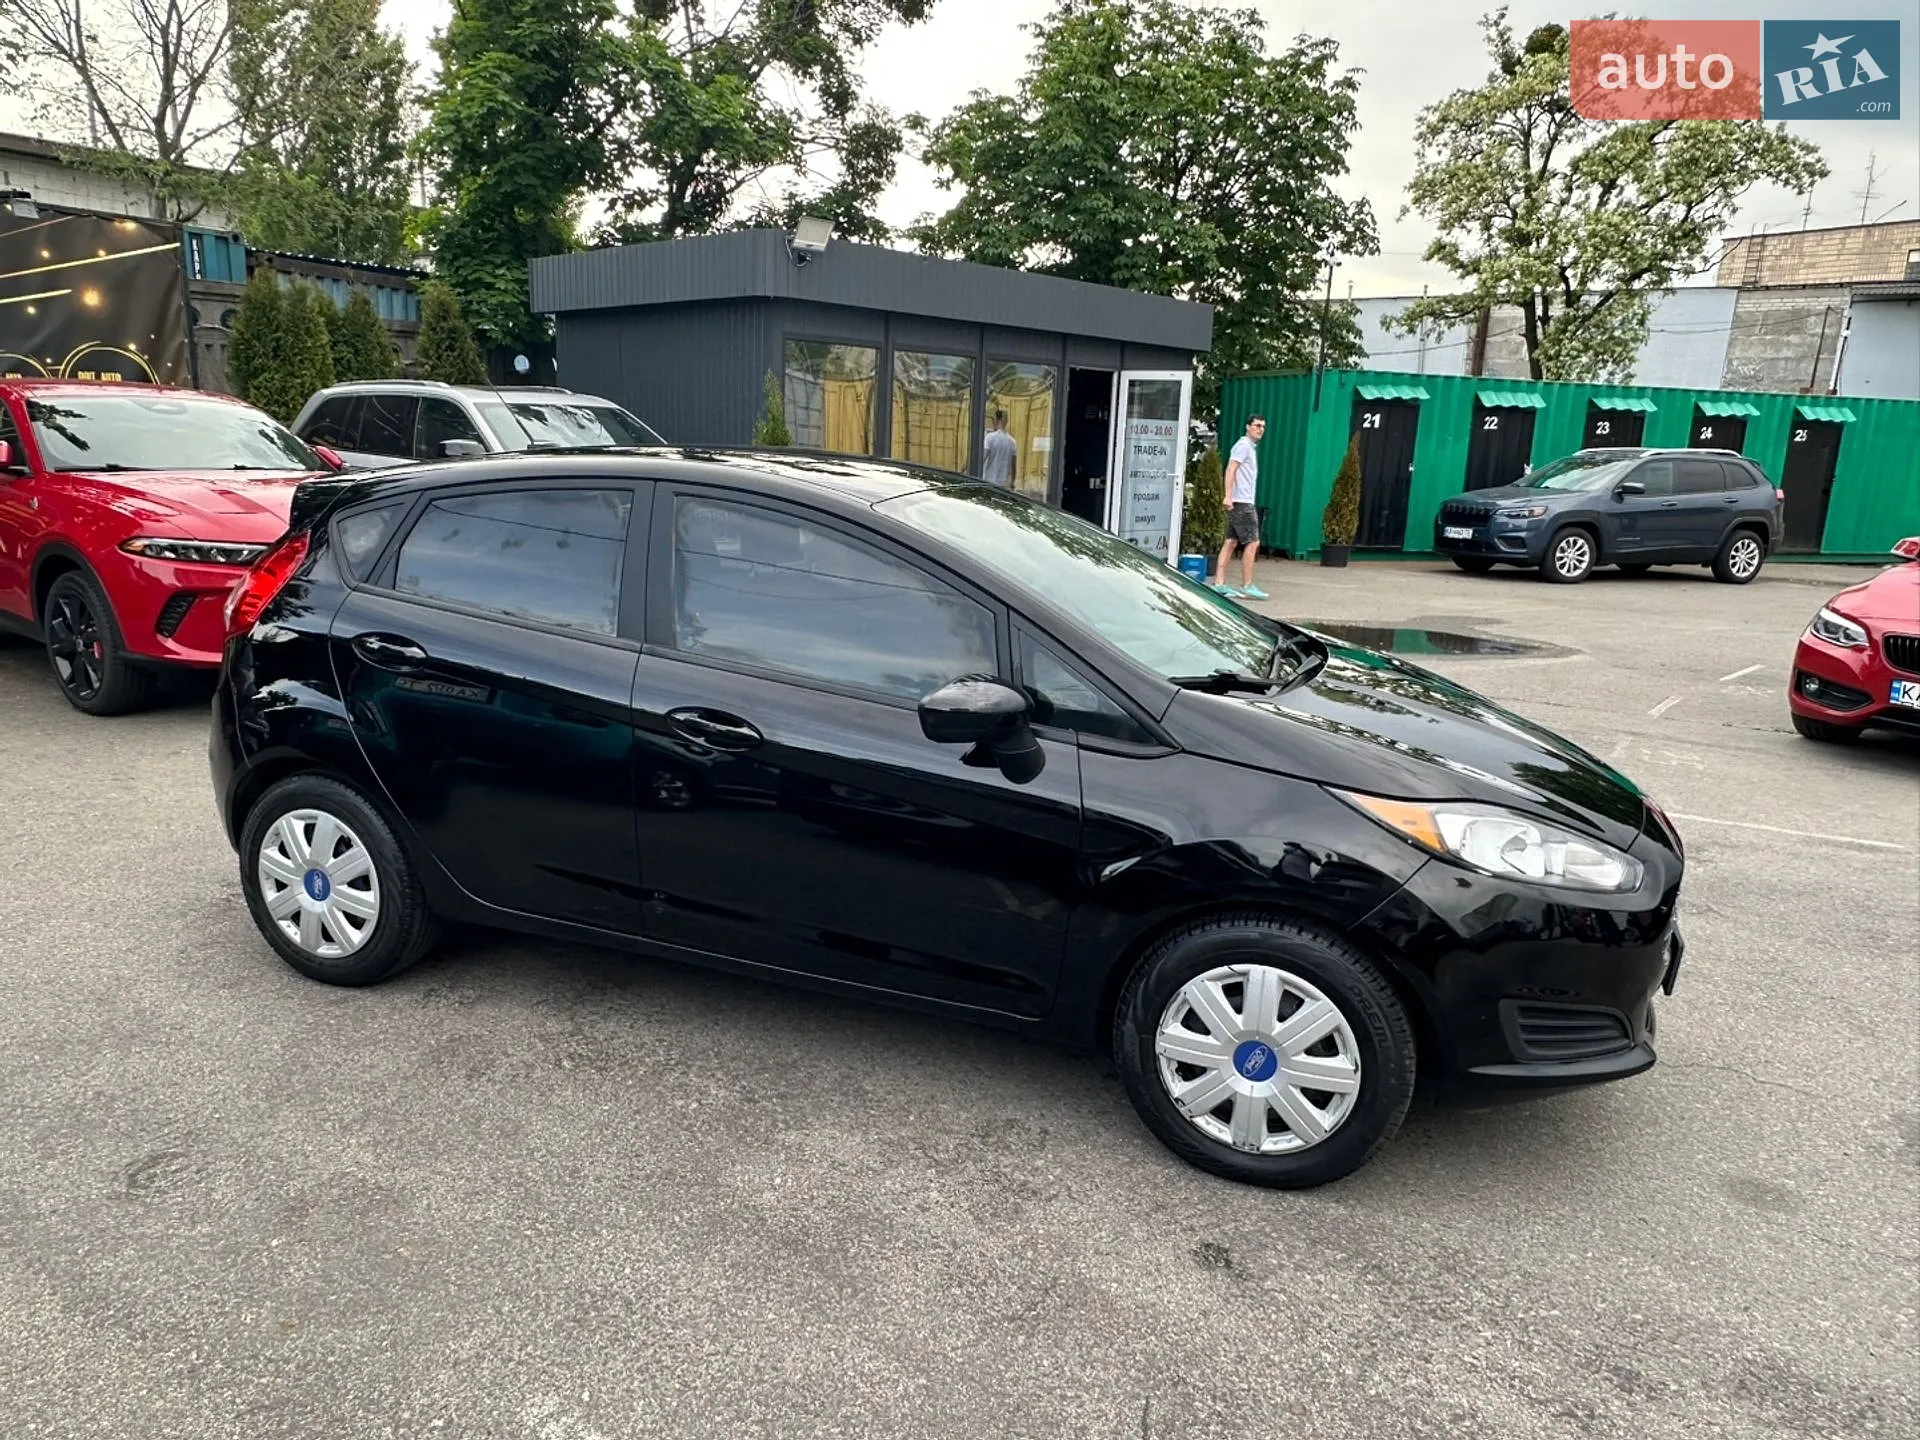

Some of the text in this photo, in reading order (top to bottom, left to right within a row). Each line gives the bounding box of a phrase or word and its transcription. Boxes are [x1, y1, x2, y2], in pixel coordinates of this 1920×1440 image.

[1362, 413, 1382, 428] 21
[1483, 416, 1499, 430] 22
[1595, 421, 1611, 435] 23
[1700, 426, 1713, 440] 24
[1133, 445, 1167, 457] TRADE-IN
